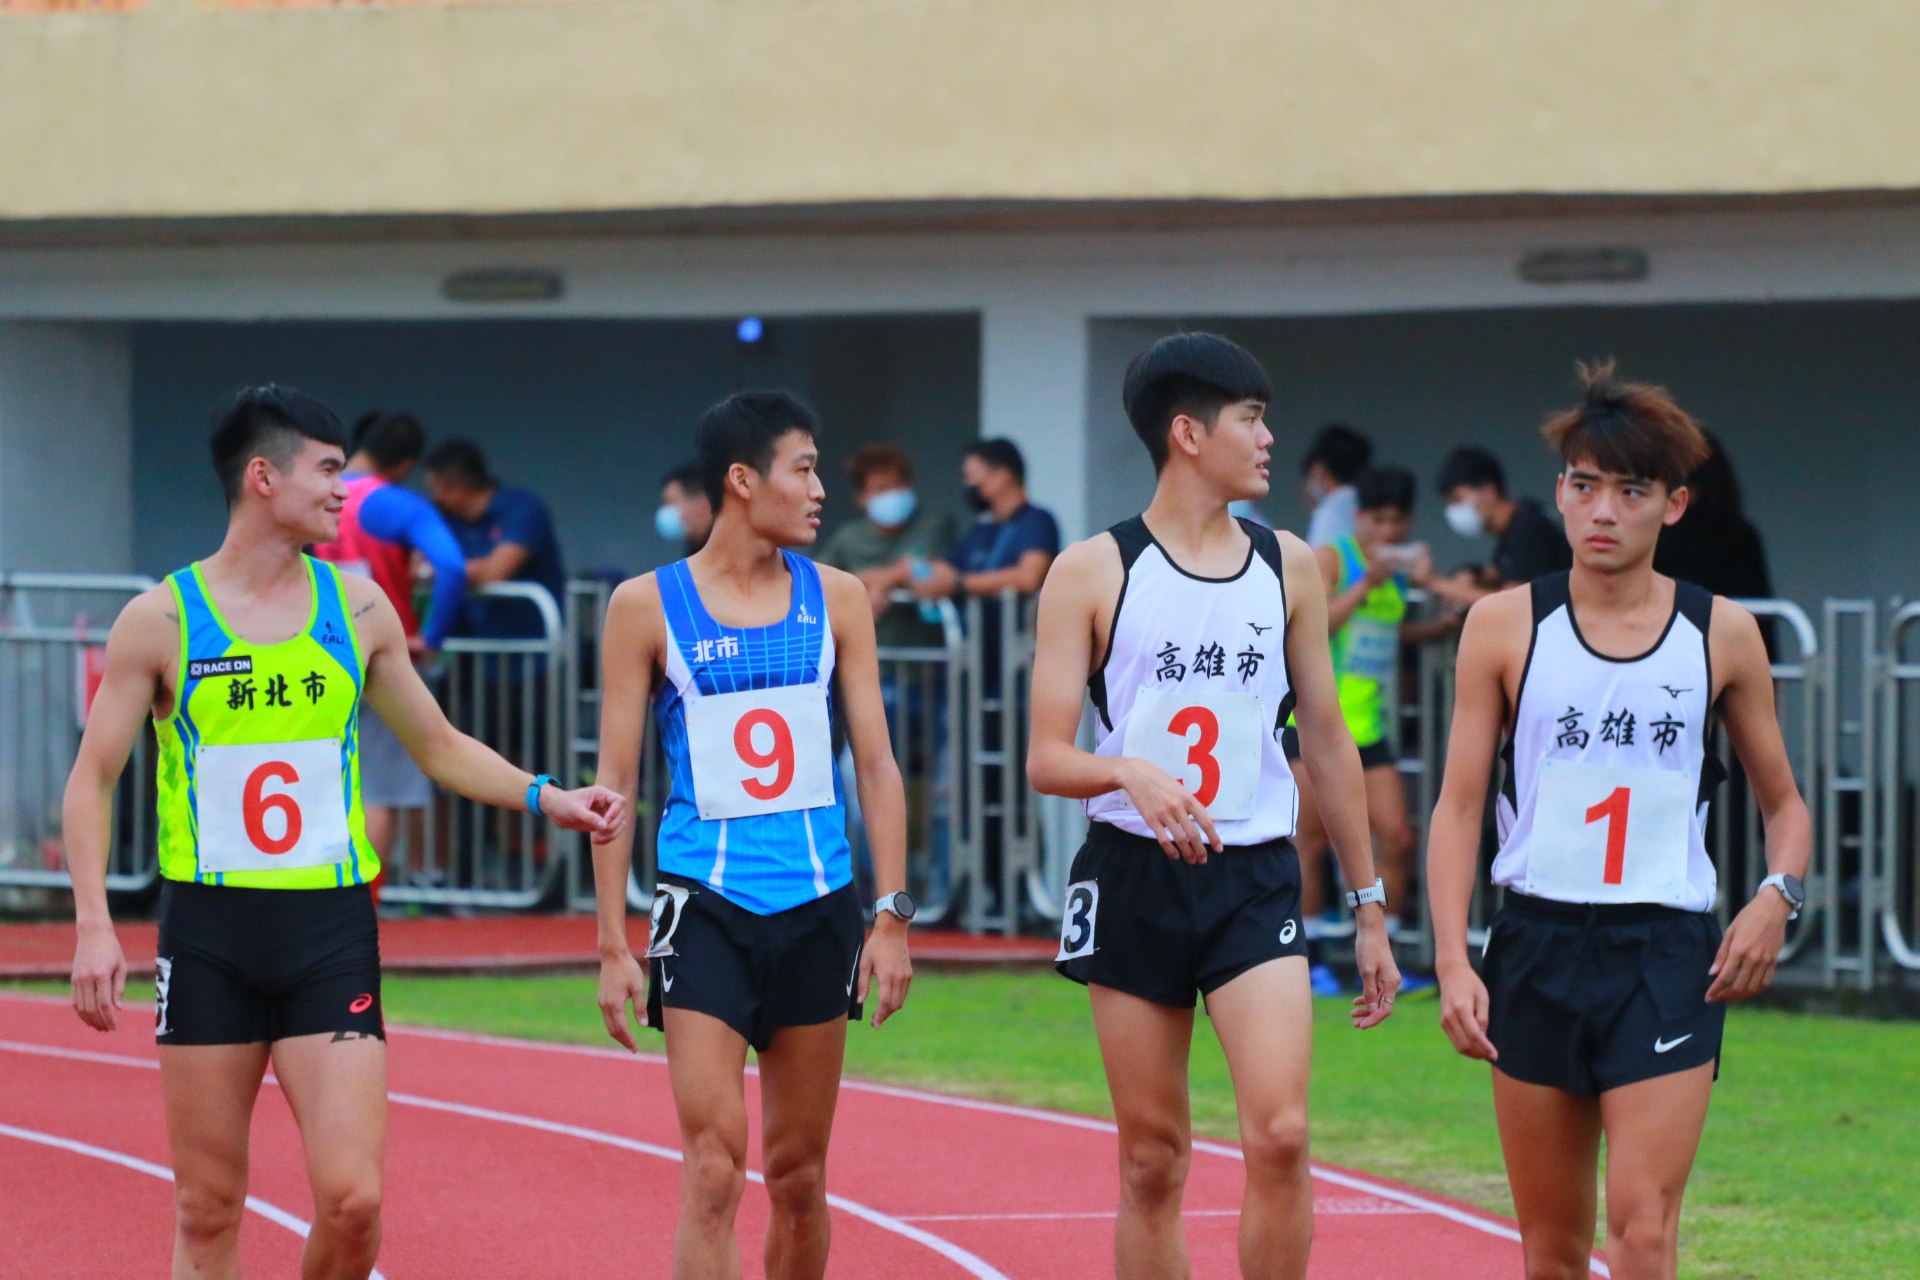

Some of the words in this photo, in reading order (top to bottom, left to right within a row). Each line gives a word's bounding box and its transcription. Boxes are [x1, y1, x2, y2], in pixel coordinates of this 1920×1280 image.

[203, 661, 232, 674] RACE
[233, 660, 251, 671] ON
[692, 636, 740, 663] 北市
[1156, 641, 1265, 685] 高雄市
[226, 671, 327, 711] 新北市
[733, 708, 795, 801] 9
[1166, 705, 1221, 809] 3
[1556, 706, 1685, 755] 高雄市
[242, 760, 302, 855] 6
[1585, 786, 1631, 885] 1
[1063, 887, 1094, 954] 3
